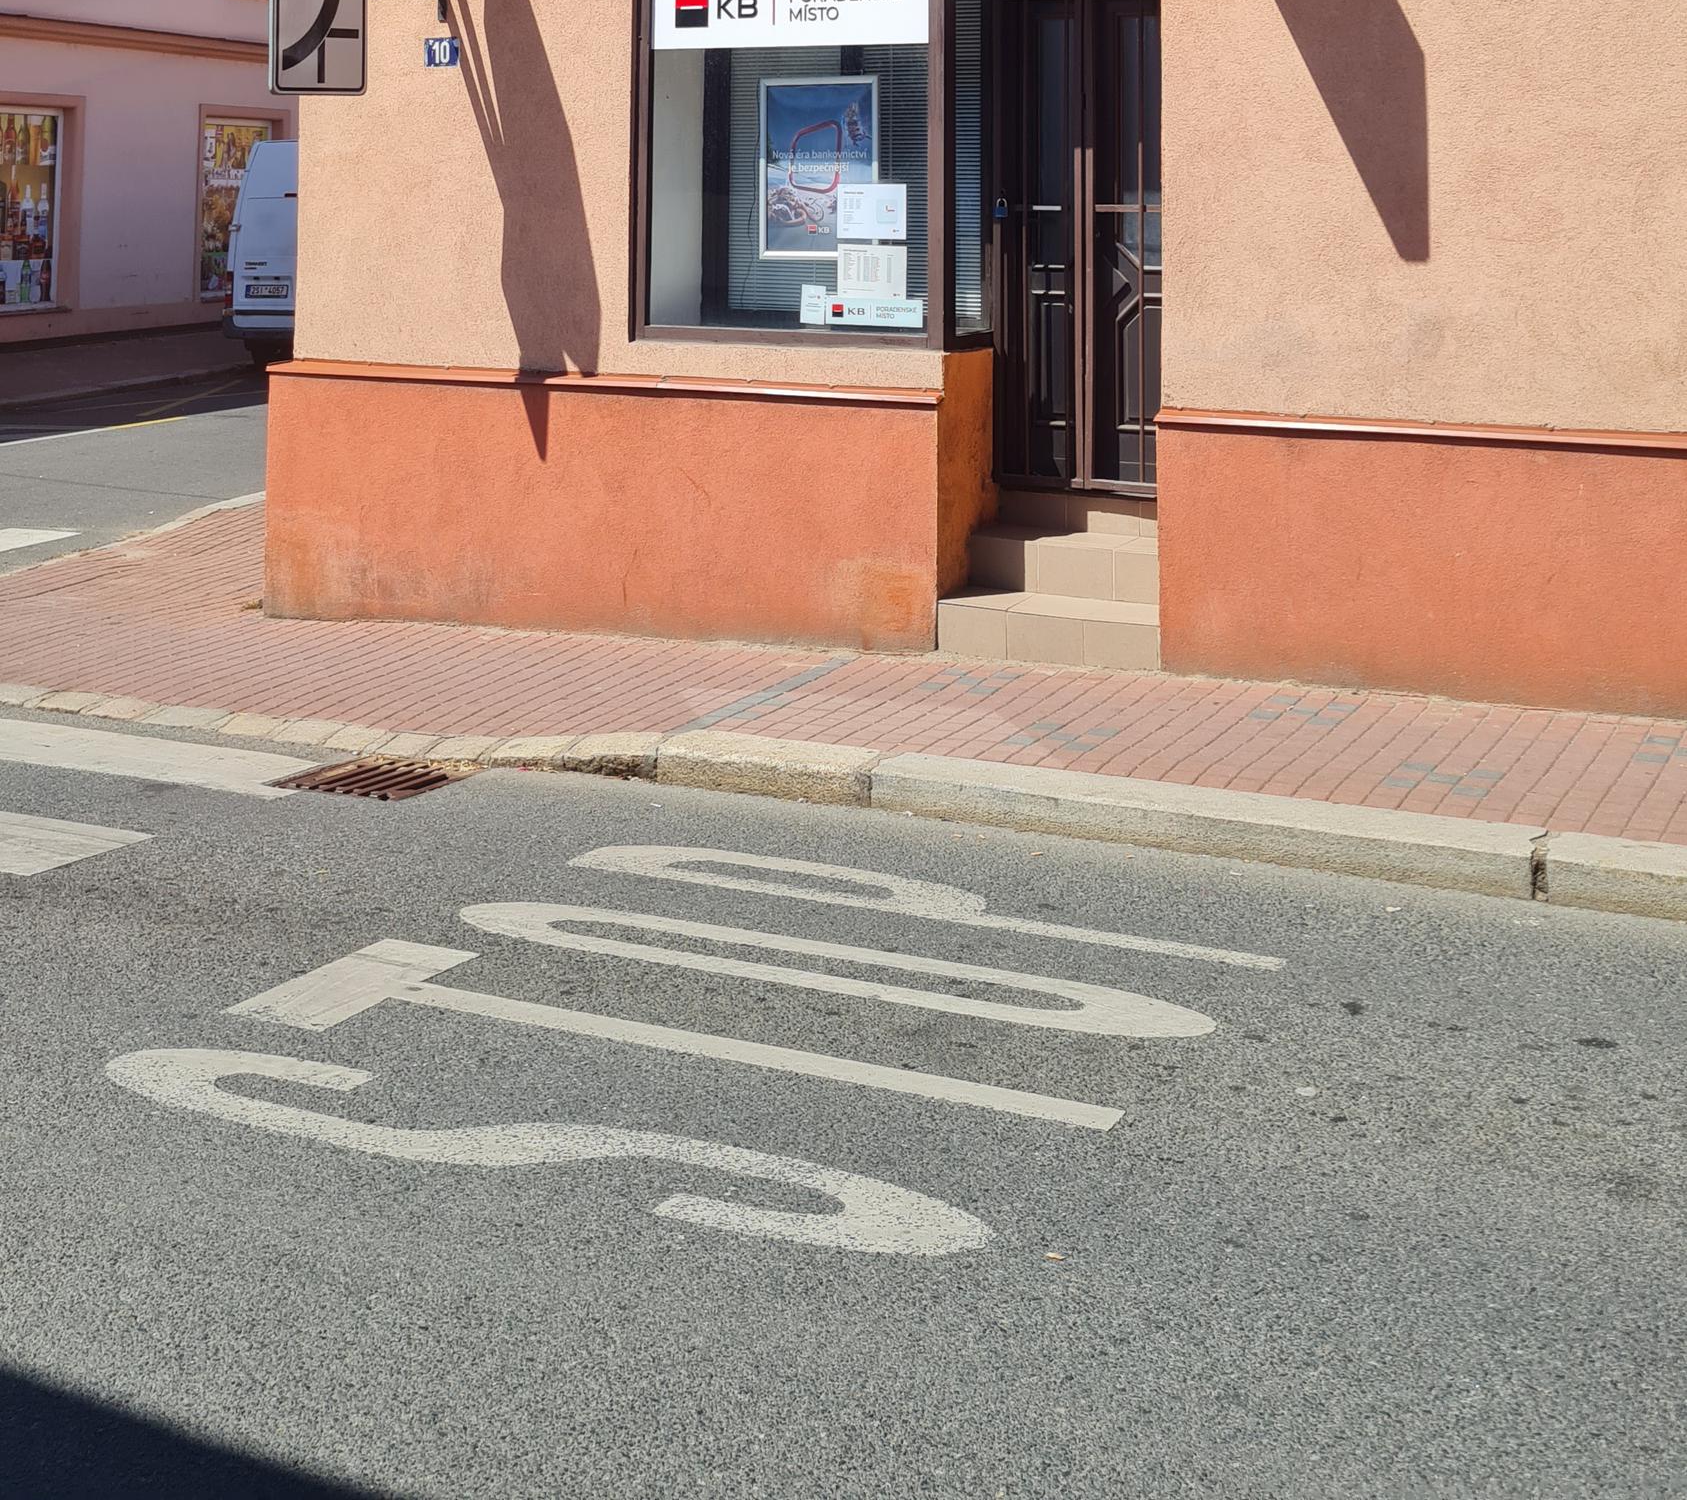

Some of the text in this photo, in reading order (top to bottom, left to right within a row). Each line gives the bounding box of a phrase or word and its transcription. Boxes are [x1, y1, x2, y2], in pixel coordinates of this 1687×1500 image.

[789, 4, 839, 22] MÍSTO
[432, 40, 450, 64] 10
[772, 150, 794, 159] Nová
[811, 148, 868, 159] bankovnictví
[817, 226, 830, 234] KB
[847, 307, 866, 316] KB
[105, 844, 1285, 1256] STOP
